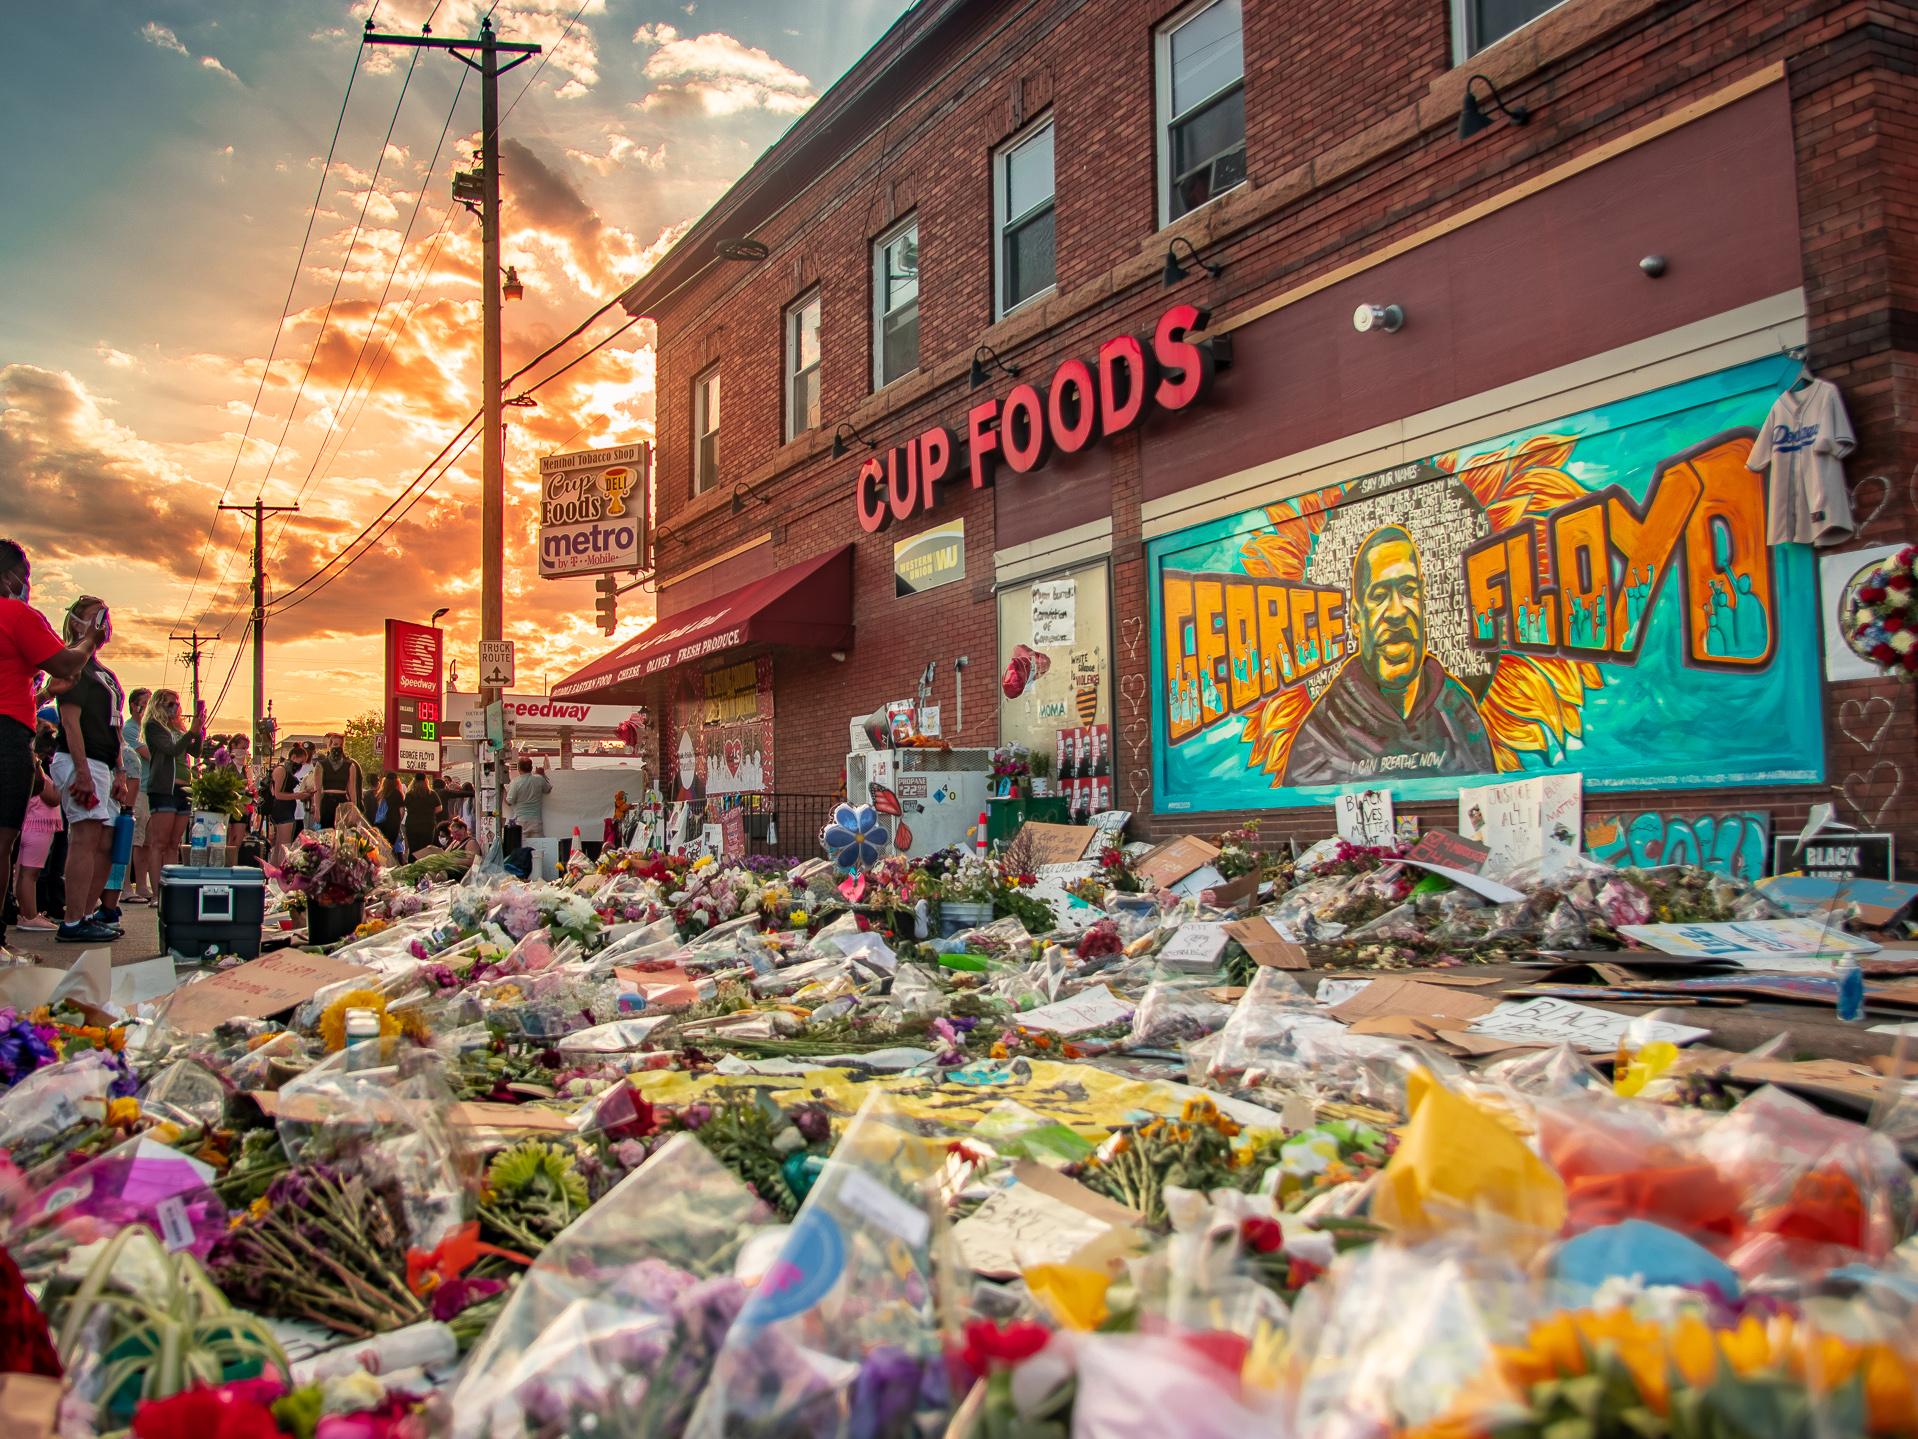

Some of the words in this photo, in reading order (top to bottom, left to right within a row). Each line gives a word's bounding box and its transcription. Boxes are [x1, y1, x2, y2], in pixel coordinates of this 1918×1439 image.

[857, 427, 952, 533] CUP
[969, 304, 1202, 488] FOODS
[543, 458, 575, 471] Menthol
[577, 452, 611, 467] Tobacco
[613, 448, 635, 461] Shop
[546, 472, 596, 502] Cup
[606, 475, 628, 491] DELI
[1379, 472, 1396, 487] OUR
[1412, 480, 1443, 500] JEREMY
[541, 496, 601, 524] Foods
[1408, 504, 1440, 521] FREDDIE
[544, 524, 634, 558] metro
[1464, 432, 1774, 669] FLOYD
[899, 552, 933, 574] WESTERN
[909, 563, 933, 580] UNION
[1424, 582, 1452, 600] SHELLY
[483, 643, 511, 653] TRUCK
[1427, 636, 1452, 653] ALTON
[483, 653, 511, 663] ROUTE
[597, 674, 612, 687] FOOD
[618, 664, 641, 681] CHEESE
[647, 654, 671, 672] OLIVES
[677, 642, 702, 662] FRESH
[701, 630, 740, 653] PRODUCE
[1071, 653, 1088, 665] WHITE
[1162, 575, 1348, 744] GEORGE
[400, 675, 437, 692] Speedway
[400, 750, 418, 759] GEORGE
[419, 751, 435, 761] FLOYD
[1358, 756, 1377, 773] CAN
[1381, 753, 1419, 772] BREATHE
[1419, 750, 1446, 768] NOW
[1805, 846, 1860, 866] BLACK
